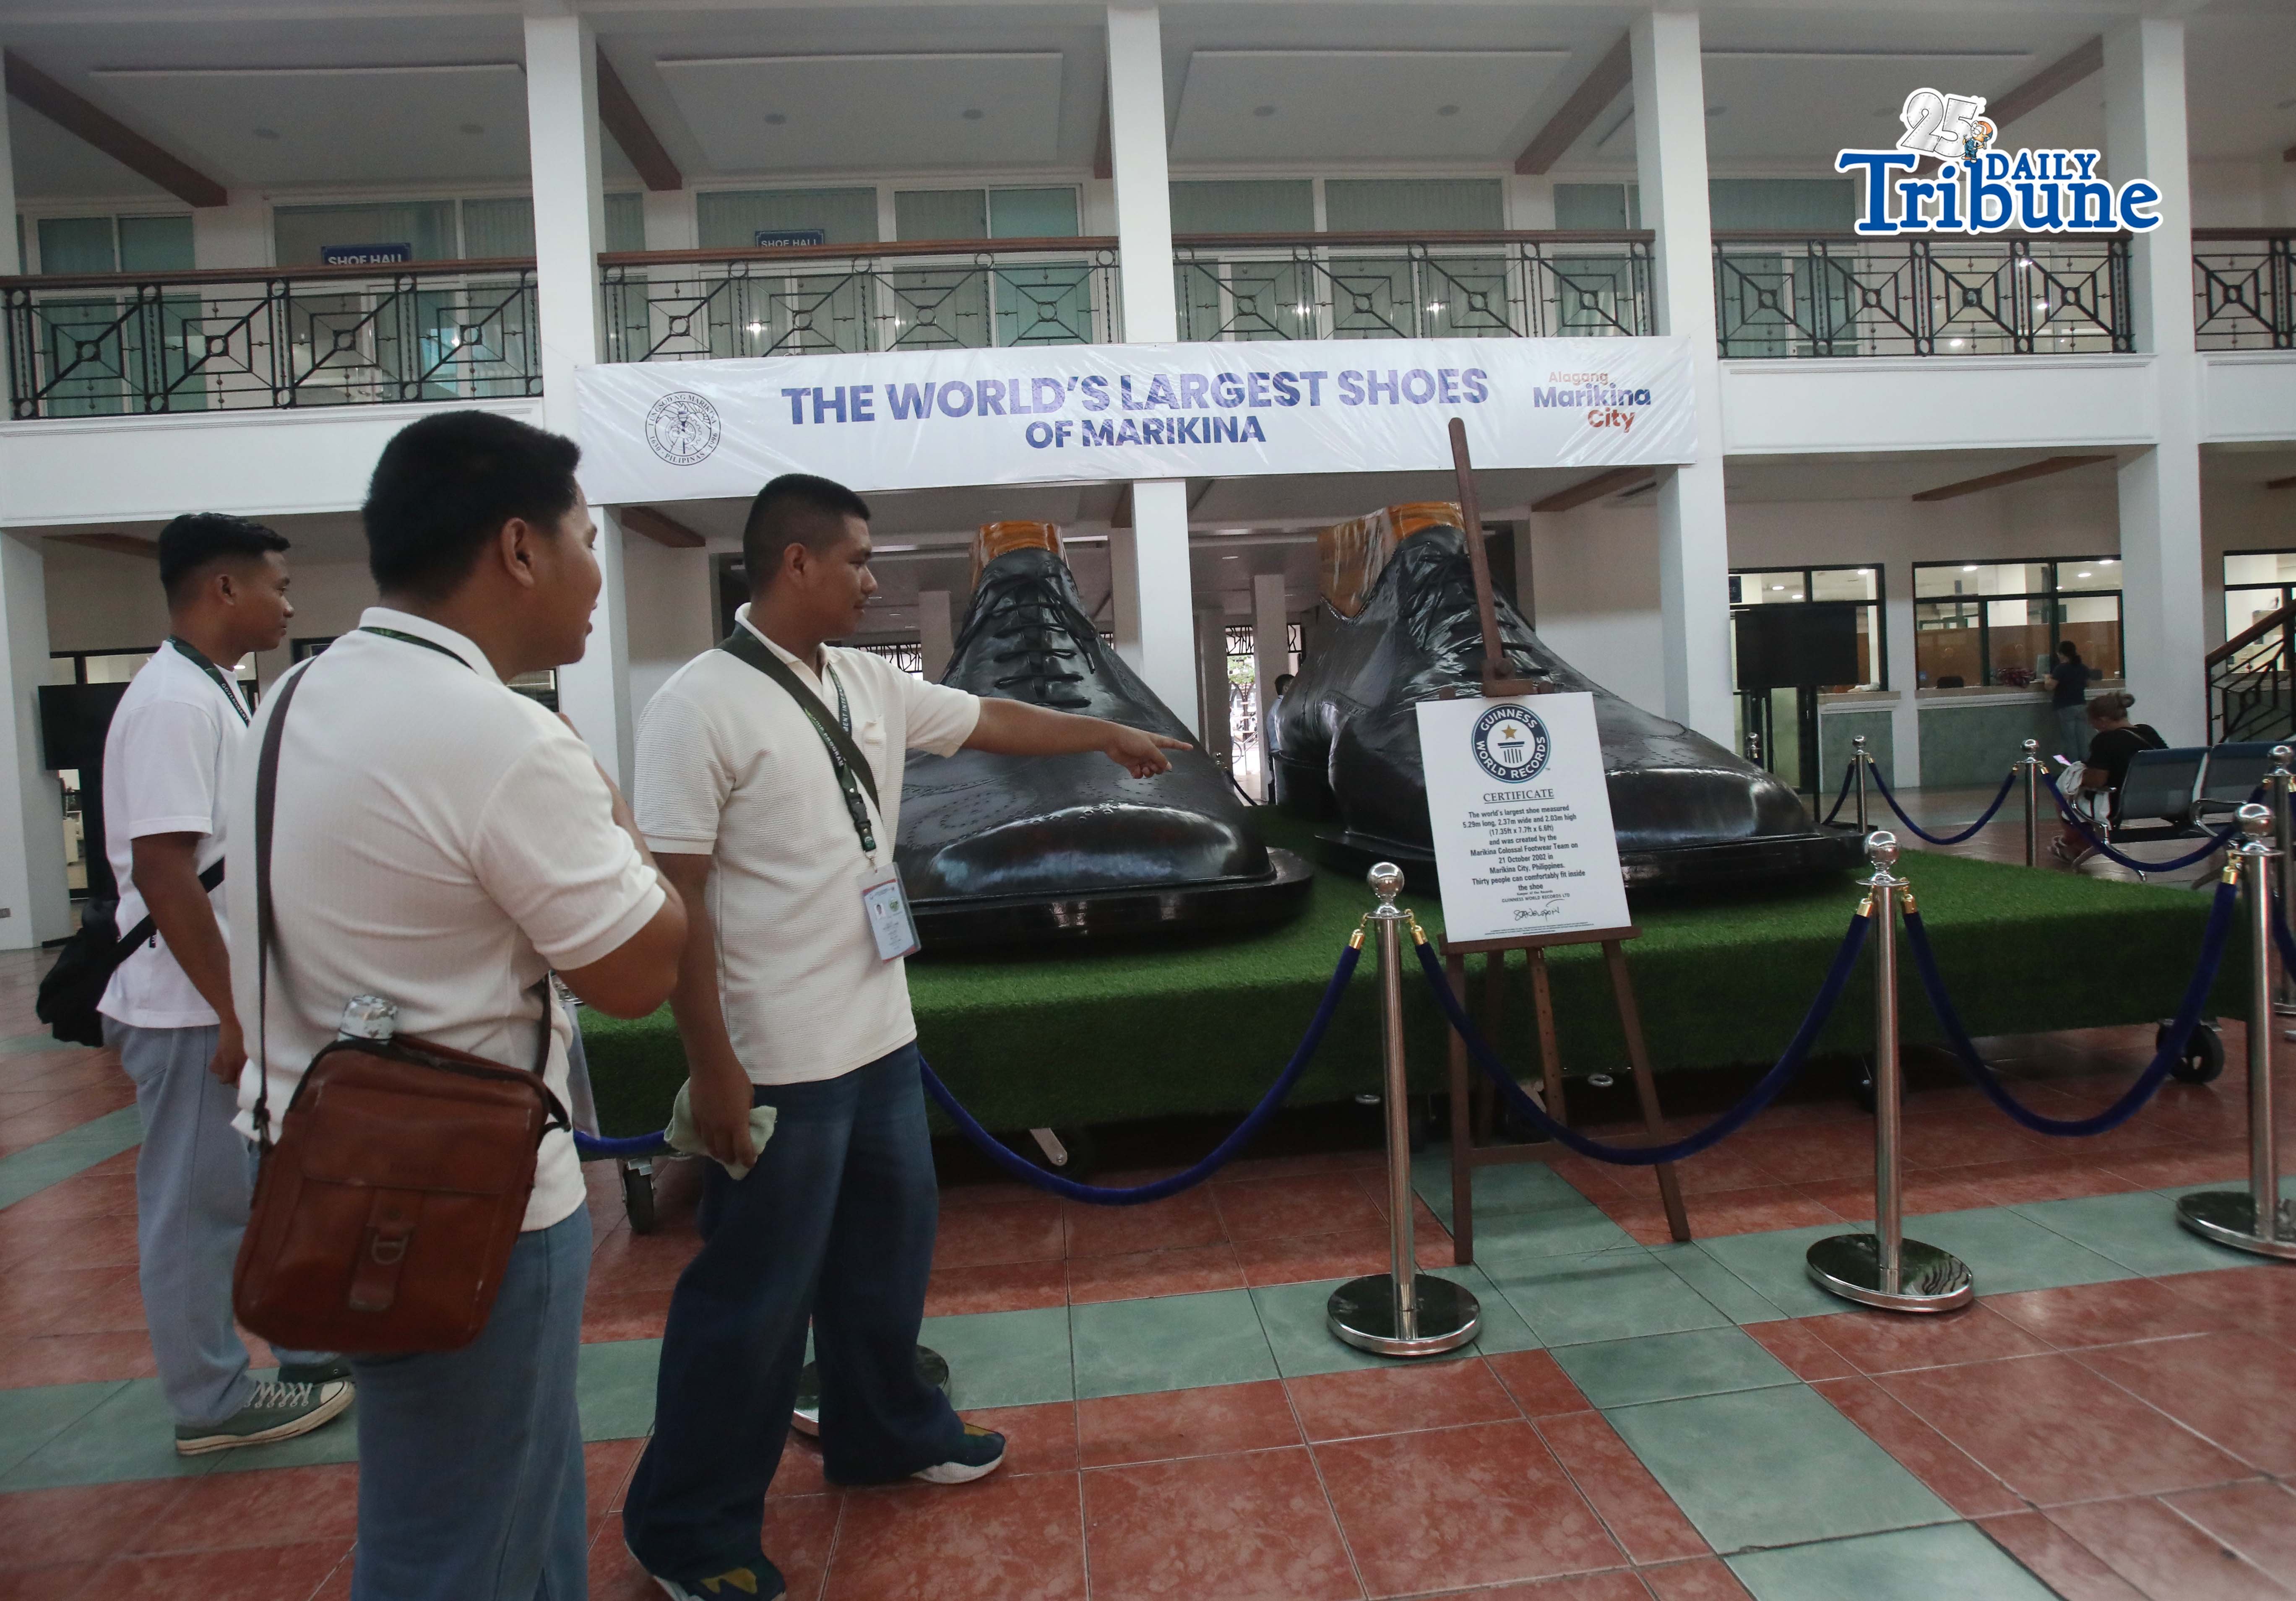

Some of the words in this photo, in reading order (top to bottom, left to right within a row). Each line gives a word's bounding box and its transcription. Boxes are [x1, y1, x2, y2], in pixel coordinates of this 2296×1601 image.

[328, 255, 367, 265] SHOE
[1549, 371, 1609, 385] Alagang
[781, 384, 875, 425] THE
[885, 374, 1109, 421] WORLD'S
[1121, 369, 1329, 412] LARGEST
[1338, 368, 1489, 406] SHOES
[1533, 383, 1651, 408] Marikina
[688, 395, 717, 424] MARIKINA
[1588, 407, 1635, 433] City
[1025, 420, 1077, 449] OF
[1082, 414, 1267, 447] MARIKINA
[650, 436, 661, 452] 1630
[708, 433, 718, 449] 1996
[665, 452, 705, 463] PILIPINAS
[1480, 709, 1537, 731] GUINNESS
[823, 732, 844, 767] PROGRAM
[1476, 740, 1506, 776] WORLD
[1511, 736, 1546, 779] RECORDS
[1483, 789, 1554, 802] CERTIFICATE
[1489, 827, 1512, 837] (17.35ft
[1524, 844, 1552, 852] Footwear
[1524, 872, 1559, 881] comfortably
